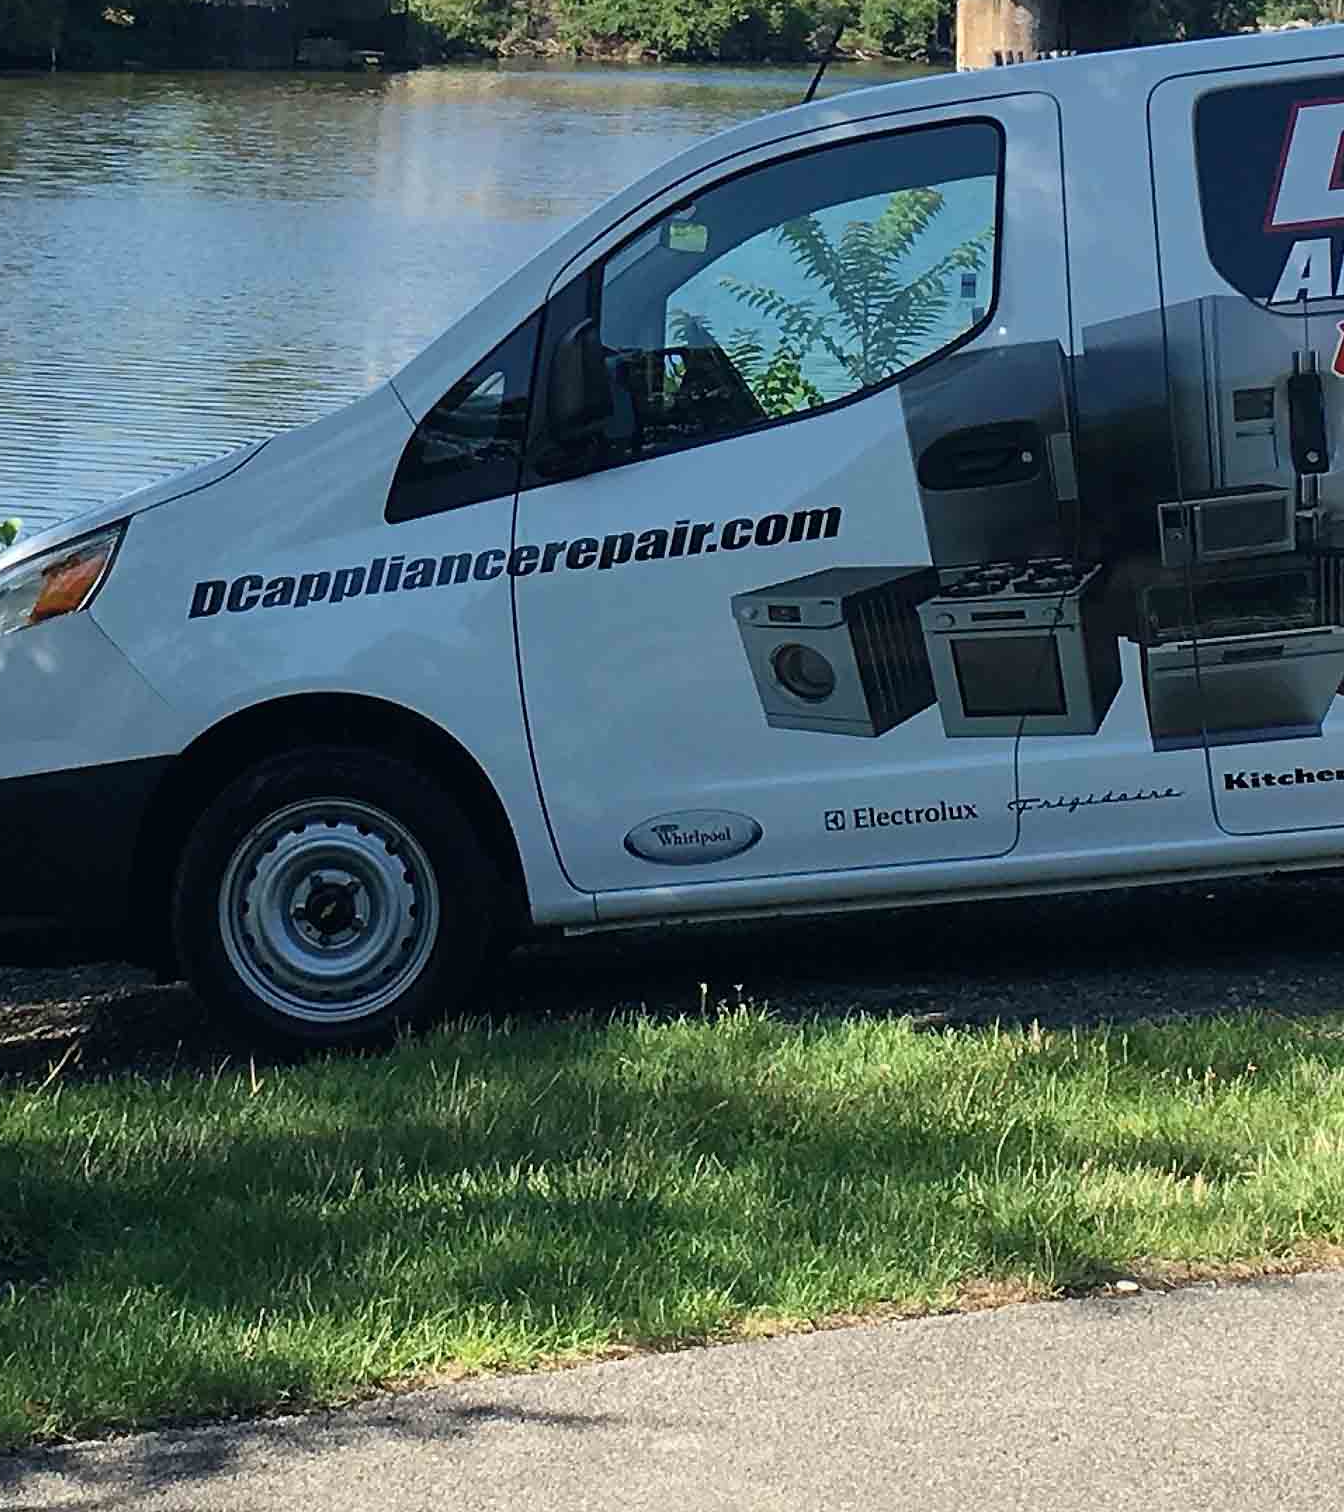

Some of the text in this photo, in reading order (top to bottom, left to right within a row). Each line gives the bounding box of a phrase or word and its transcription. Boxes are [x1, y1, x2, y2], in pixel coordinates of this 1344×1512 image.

[188, 504, 844, 620] DCappliancerepair.com
[852, 799, 979, 830] Electrolux
[650, 823, 732, 849] Whirlpool
